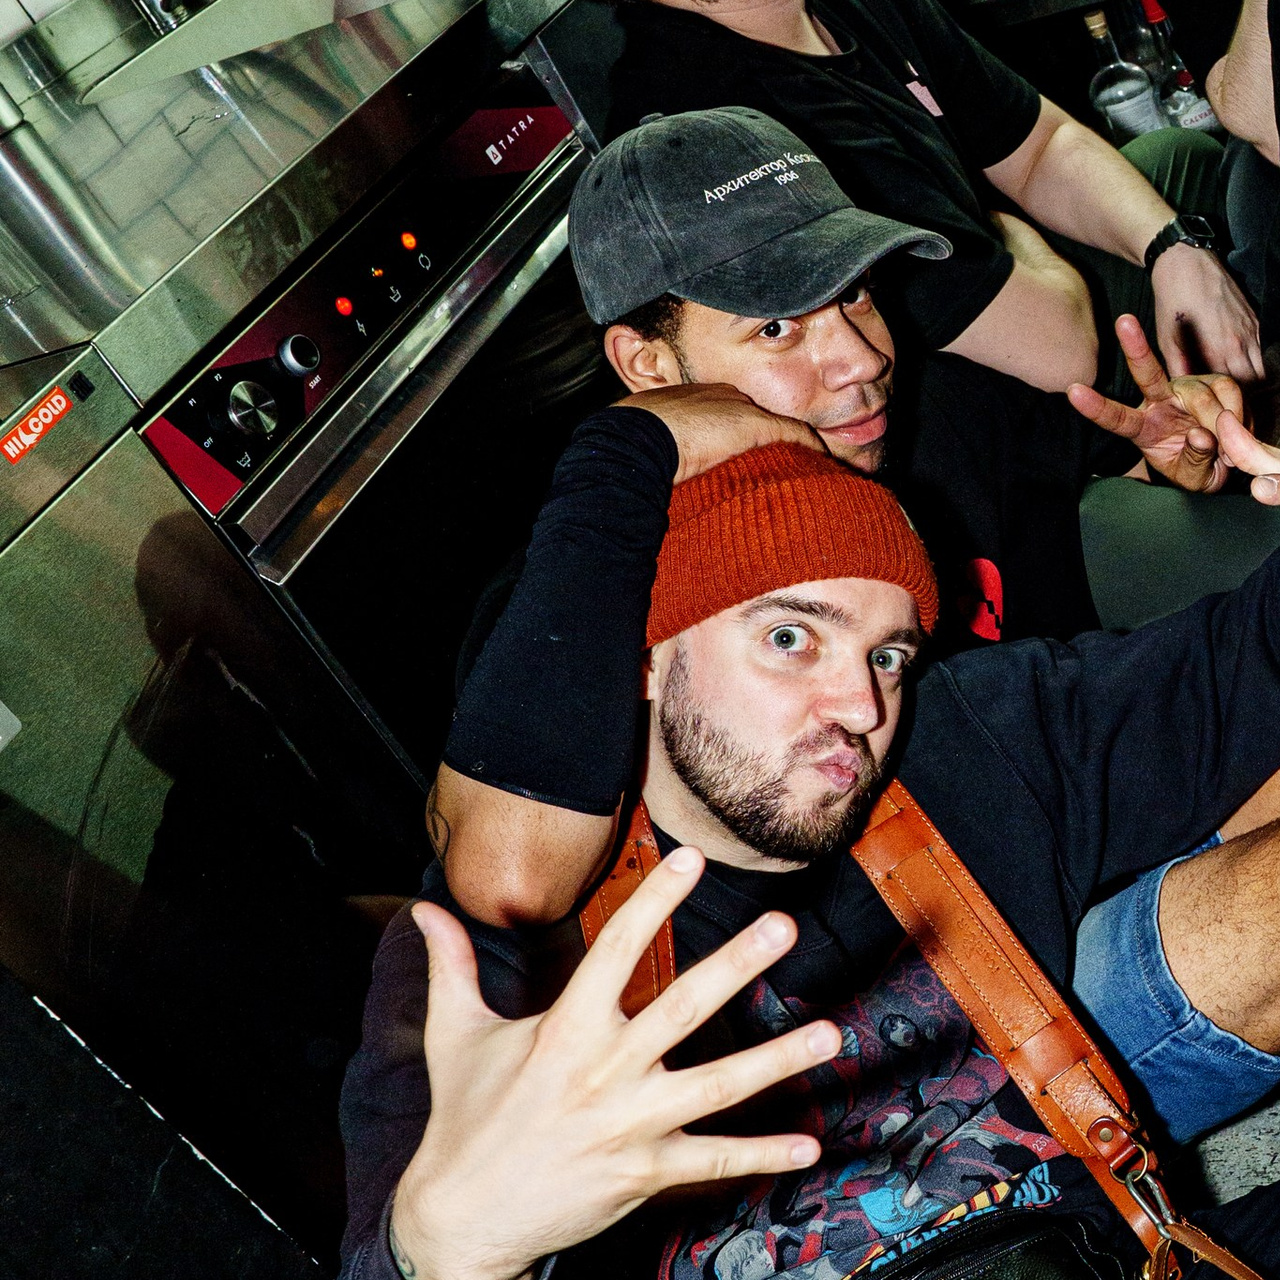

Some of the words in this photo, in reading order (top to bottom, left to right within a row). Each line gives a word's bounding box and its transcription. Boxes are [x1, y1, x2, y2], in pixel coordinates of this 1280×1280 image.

[498, 114, 535, 150] TATRA
[703, 158, 788, 204] Архитектор
[774, 170, 800, 186] 1906
[213, 372, 223, 383] P2
[308, 374, 322, 390] START
[188, 397, 197, 407] P1
[28, 393, 67, 434] COLD
[203, 436, 214, 449] OFF
